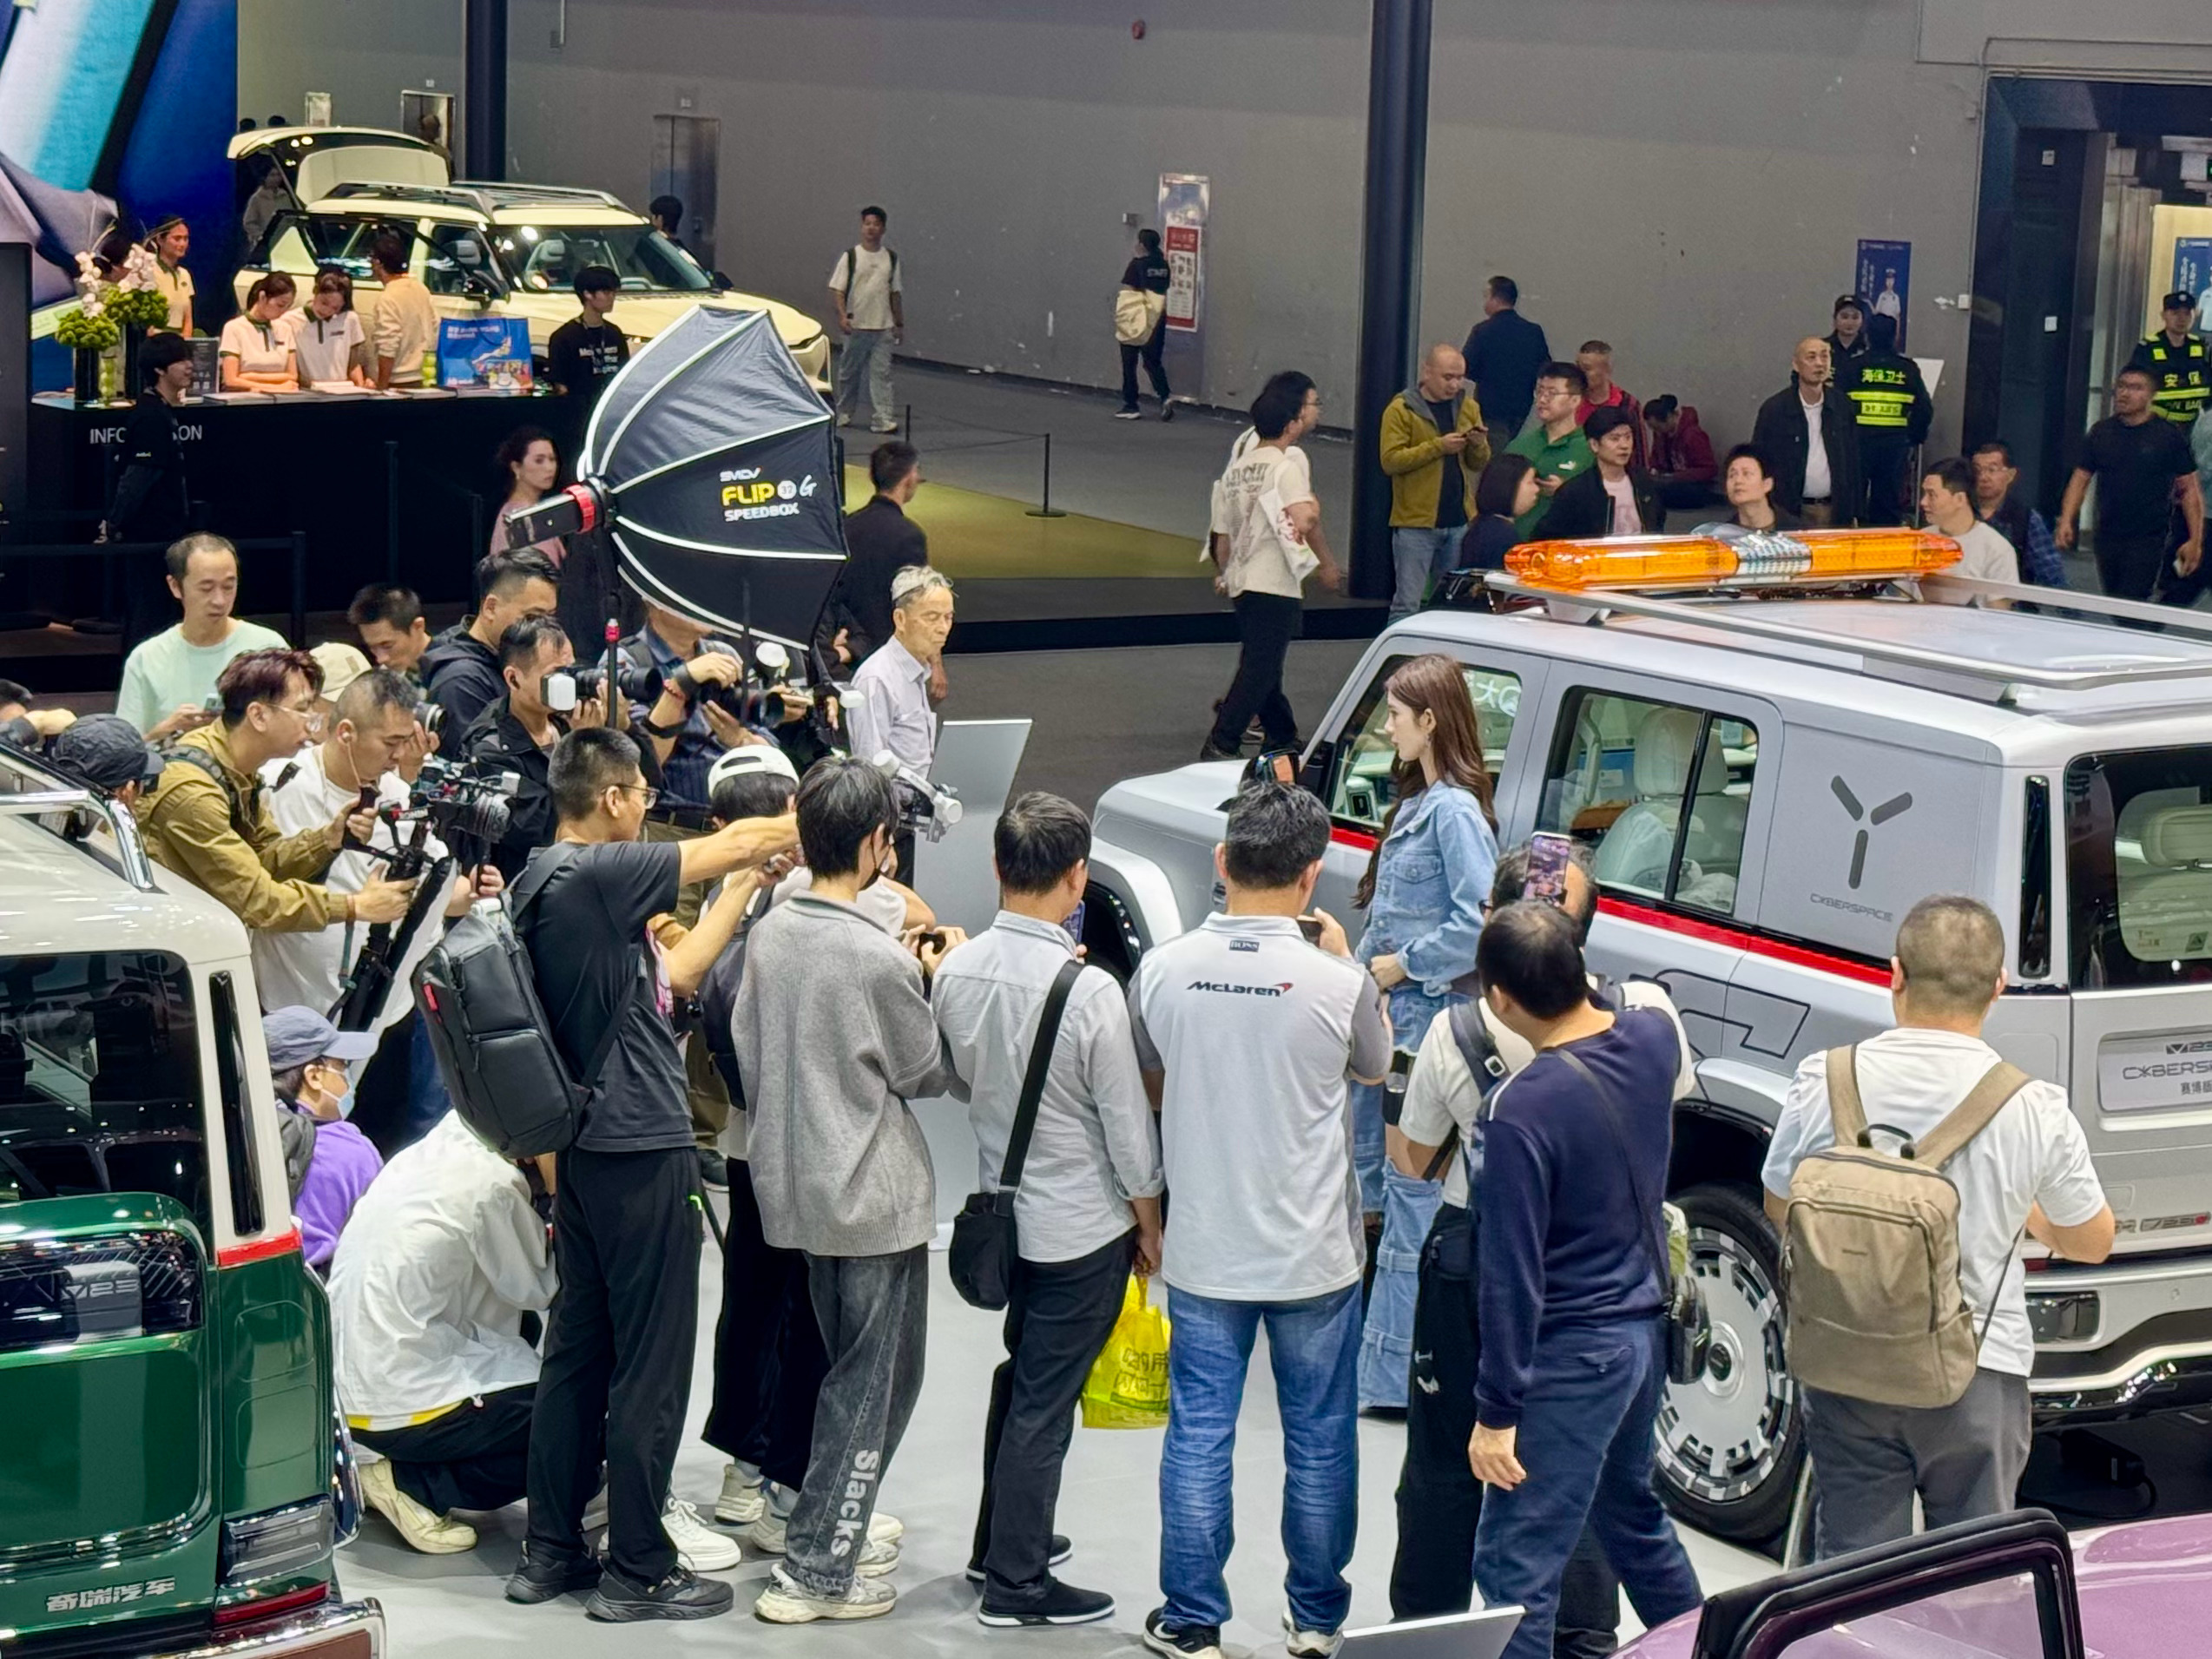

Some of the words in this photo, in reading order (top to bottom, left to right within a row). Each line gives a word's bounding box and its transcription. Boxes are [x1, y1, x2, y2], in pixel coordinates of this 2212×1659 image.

[721, 483, 775, 506] FLIP
[723, 502, 800, 522] SPEEDBOX
[1186, 980, 1280, 997] McLaren
[830, 1449, 879, 1557] Slacks
[46, 1577, 175, 1613] 奇瑞汽车
